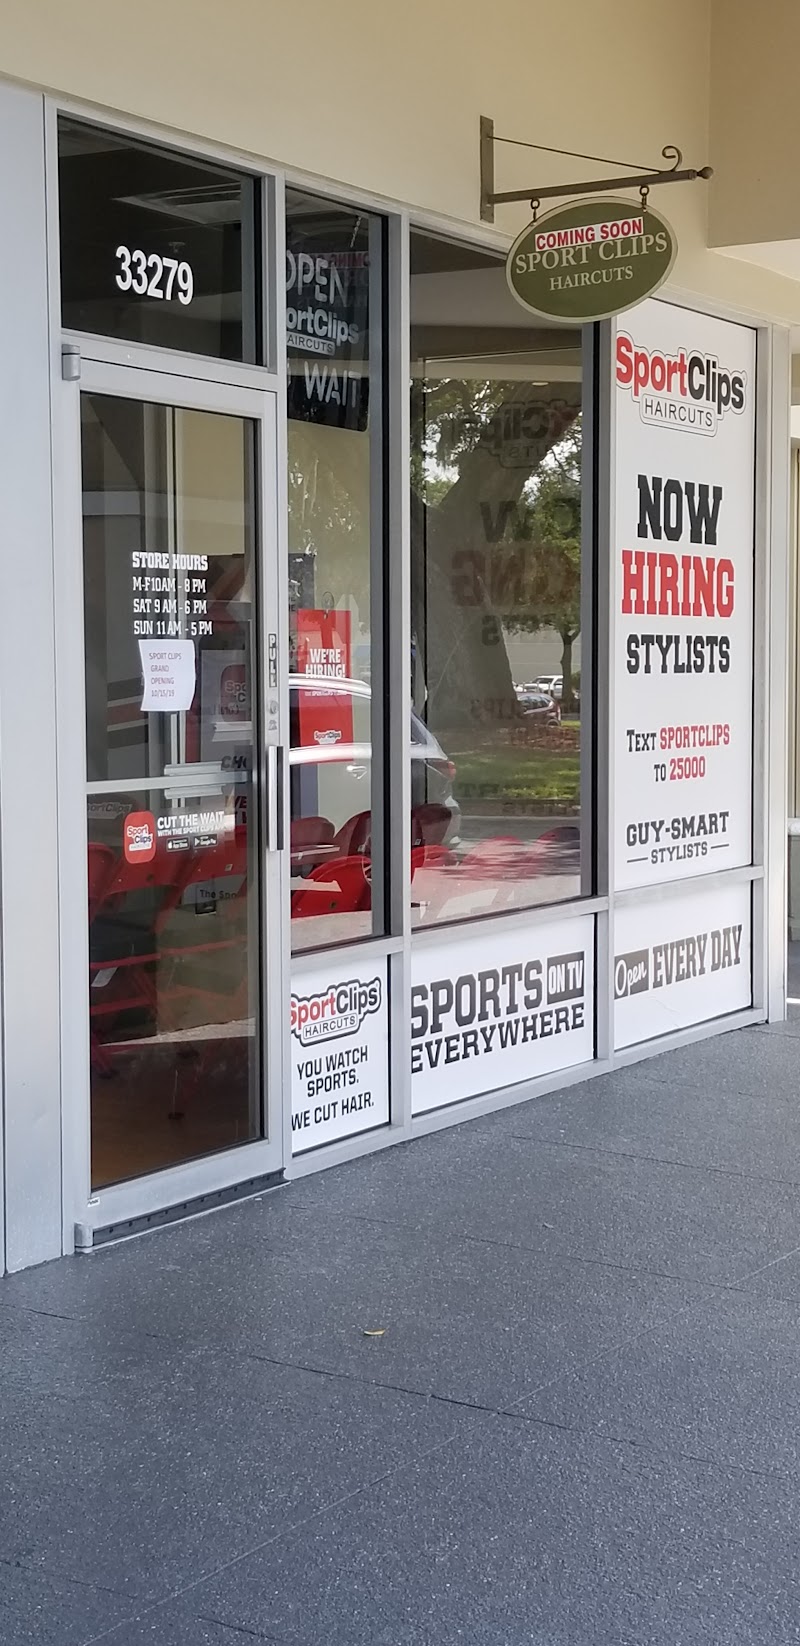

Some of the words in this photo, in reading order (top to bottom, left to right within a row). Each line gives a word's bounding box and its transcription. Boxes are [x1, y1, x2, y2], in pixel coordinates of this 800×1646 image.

[535, 228, 596, 251] COMING
[599, 218, 643, 239] SOON
[515, 246, 592, 275] SPORT
[598, 231, 668, 260] CLIPS
[115, 245, 194, 306] 33279
[549, 265, 634, 291] HAIRCUTS
[286, 306, 359, 346] ortClips
[286, 334, 334, 353] AIRCUTS
[304, 361, 362, 408] WAIT
[616, 335, 745, 415] SportClips
[644, 397, 713, 427] HAIRCUTS
[637, 474, 723, 546] NOW
[132, 551, 170, 569] STORE
[171, 554, 209, 571] HOURS
[184, 578, 190, 592] 8
[192, 578, 206, 593] PM
[621, 549, 735, 618] HIRING
[133, 598, 151, 613] SAT
[154, 599, 161, 613] 9
[162, 599, 177, 614] AM
[184, 600, 191, 614] 6
[193, 600, 207, 614] PM
[133, 620, 153, 635] SUN
[156, 620, 166, 635] 11
[167, 620, 181, 635] AM
[191, 620, 197, 635] 5
[199, 620, 212, 635] PM
[149, 653, 167, 661] SPORT
[168, 653, 182, 661] CLIPS
[151, 664, 169, 673] GRAND
[269, 633, 278, 687] PULL
[310, 648, 341, 664] WE'RE
[626, 633, 730, 674] STYLISTS
[151, 677, 175, 685] OPENING
[659, 723, 731, 749] SPORTCLIPS
[669, 755, 706, 780] 25000
[157, 815, 177, 829] CUT
[180, 813, 198, 826] THE
[199, 811, 224, 824] WAIT
[626, 811, 730, 847] GUY-SMART
[650, 840, 708, 865] STYLISTS
[614, 957, 648, 996] Open
[652, 936, 706, 989] EVERY
[710, 924, 743, 971] DAY
[411, 959, 543, 1038] SPORTS
[549, 966, 565, 995] ON
[567, 958, 584, 991] TV
[305, 1015, 356, 1038] HAIRCUTS
[411, 1002, 585, 1074] EVERYWHERE
[297, 1057, 323, 1081] YOU
[325, 1044, 369, 1074] WATCH
[307, 1067, 360, 1098] SPORTS.
[291, 1109, 311, 1132] WE
[314, 1100, 339, 1125] CUT
[341, 1090, 375, 1117] HAIR.
